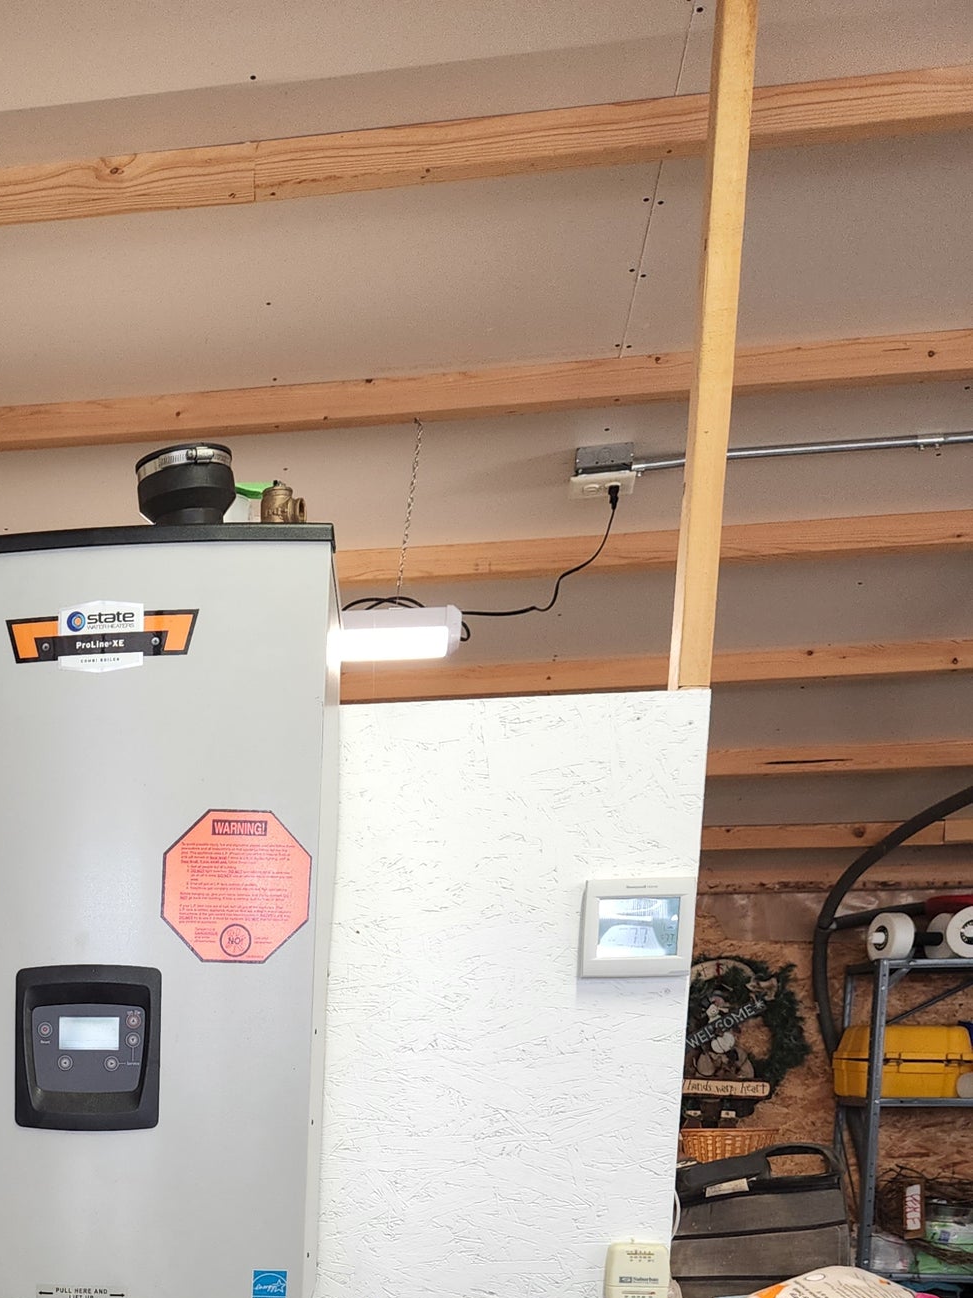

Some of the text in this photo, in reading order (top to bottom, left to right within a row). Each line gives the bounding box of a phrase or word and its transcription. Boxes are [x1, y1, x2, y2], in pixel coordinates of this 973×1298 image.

[87, 611, 134, 625] state
[76, 639, 125, 649] ProLine XE
[213, 821, 266, 835] WARNING!
[227, 936, 241, 945] NO
[686, 1003, 755, 1048] WELCOME
[740, 1082, 767, 1094] heart
